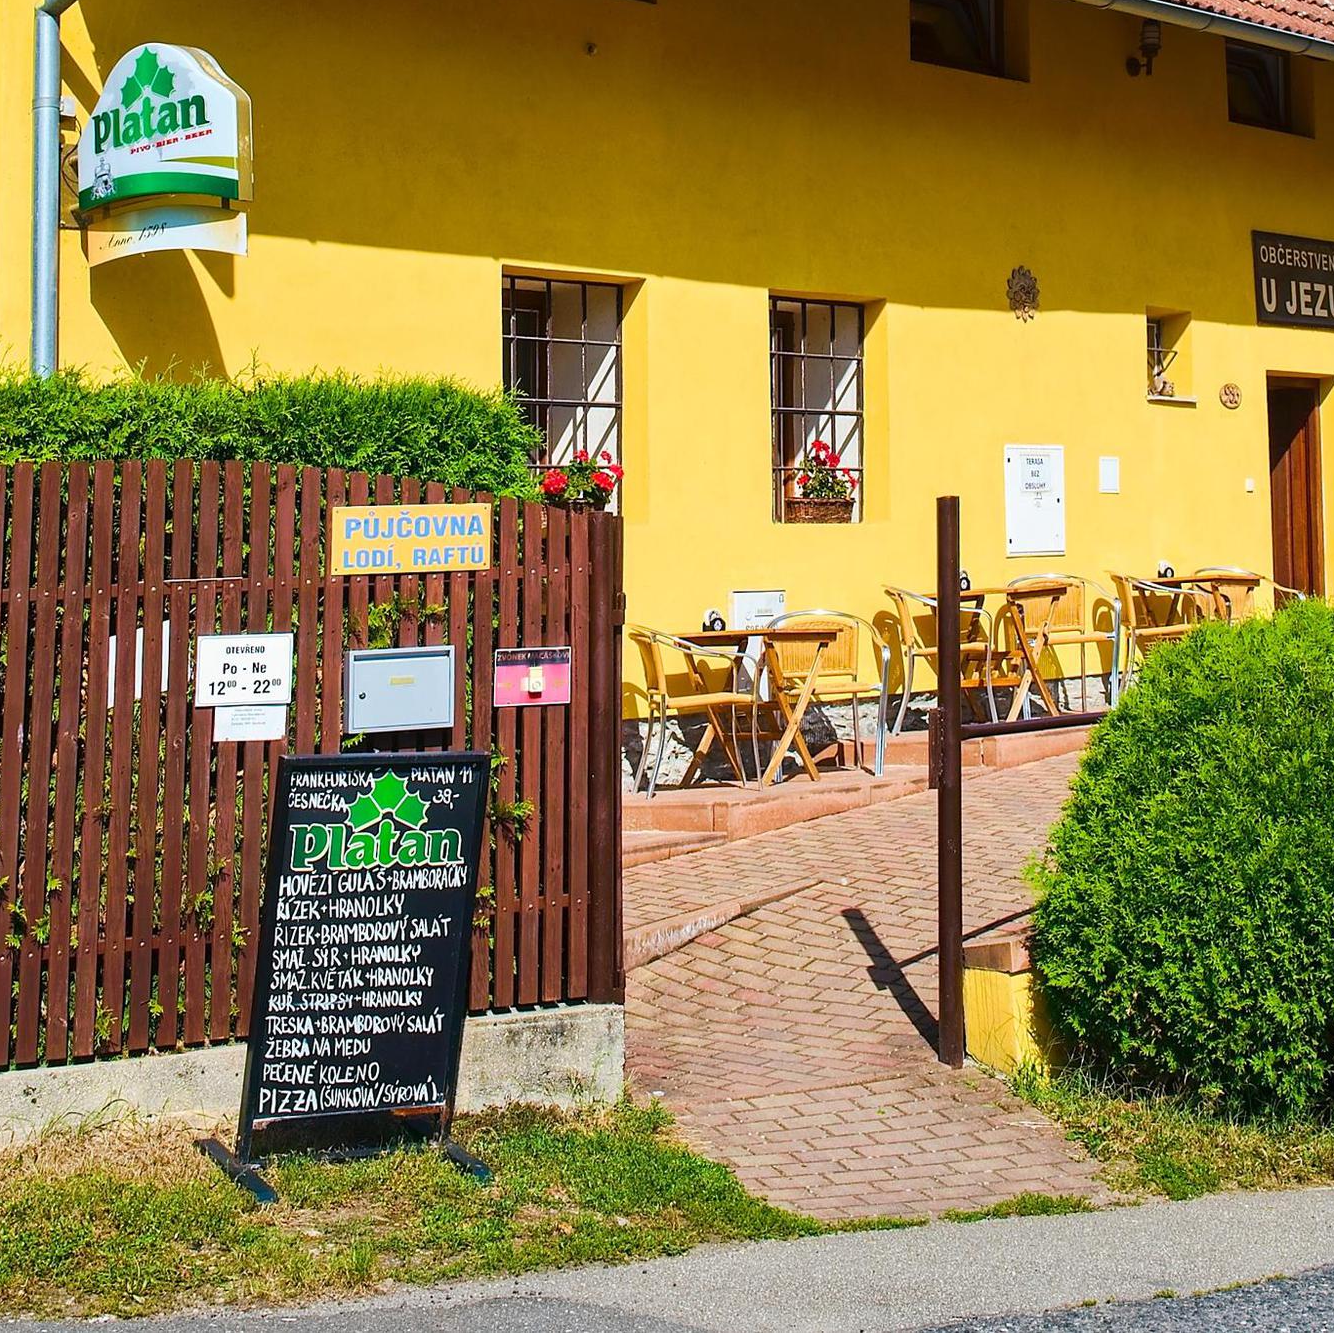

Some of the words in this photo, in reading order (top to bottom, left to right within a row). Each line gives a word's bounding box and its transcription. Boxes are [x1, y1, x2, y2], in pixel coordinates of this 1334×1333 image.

[92, 95, 210, 154] Platan
[130, 144, 151, 154] PIVO
[156, 138, 179, 147] BIER
[184, 129, 213, 140] BEER
[1261, 277, 1277, 313] U
[345, 510, 484, 540] PŮJČOVNA
[343, 544, 402, 569] LODÍ,
[225, 643, 266, 655] OTEVŘENO
[222, 663, 238, 675] Po
[252, 662, 267, 674] Ne
[290, 767, 381, 788] FRANKFURTSKÁ
[410, 765, 455, 785] PLATAN
[288, 788, 348, 813] ČESNEČKA
[290, 819, 464, 872] Platan
[410, 914, 452, 939] SALÁT
[314, 945, 341, 968] SÝR
[351, 944, 422, 965] HRANOLKY
[407, 1007, 445, 1034] SALÁT
[265, 1037, 310, 1059] ŽEBRA
[312, 1039, 331, 1058] NA
[334, 1037, 371, 1058] MEDU
[262, 1060, 318, 1085] PEČENÉ
[319, 1062, 380, 1085] KOLENO
[258, 1087, 319, 1114] PIZZA
